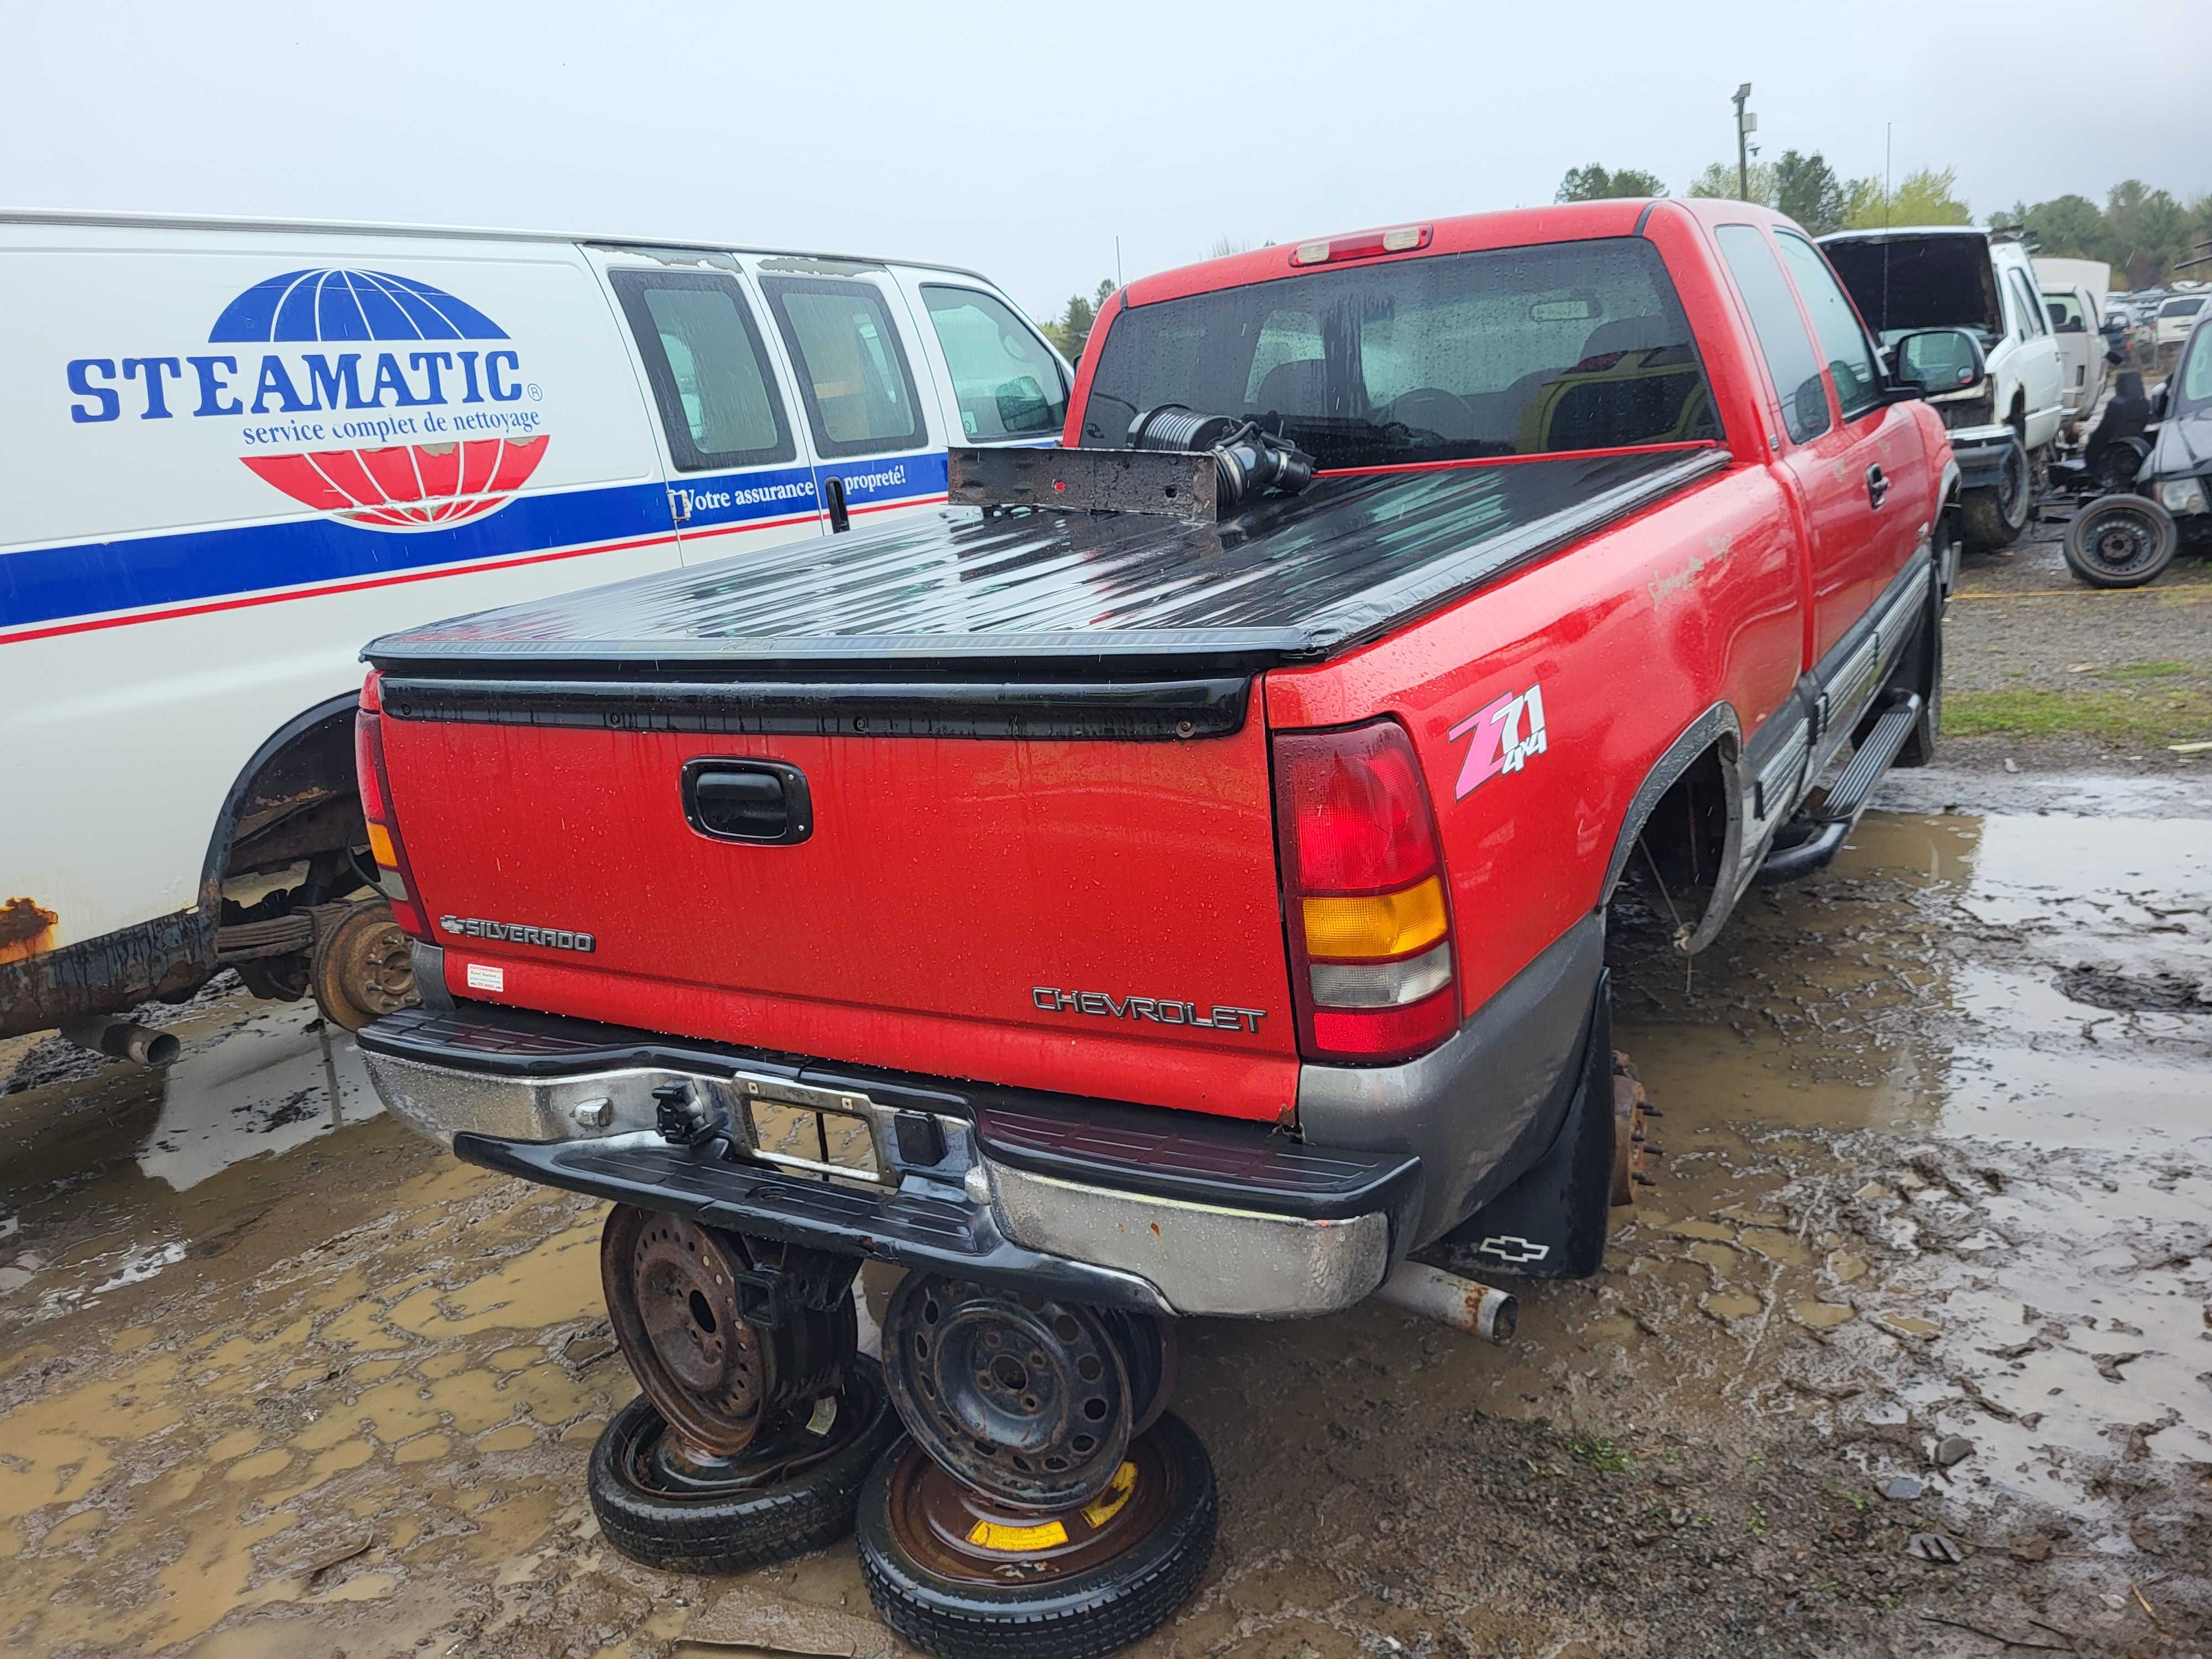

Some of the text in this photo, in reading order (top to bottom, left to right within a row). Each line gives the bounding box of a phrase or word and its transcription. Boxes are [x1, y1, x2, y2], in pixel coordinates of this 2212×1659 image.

[66, 350, 523, 424] STEAMATIC
[243, 410, 541, 445] service complet de nettoyage
[735, 481, 814, 504] assurance
[844, 465, 906, 495] propreté!
[1447, 682, 1546, 804] Z71
[1501, 728, 1548, 776] 4x4
[466, 918, 594, 952] SILVERADO
[1032, 987, 1267, 1033] CHEVROLET
